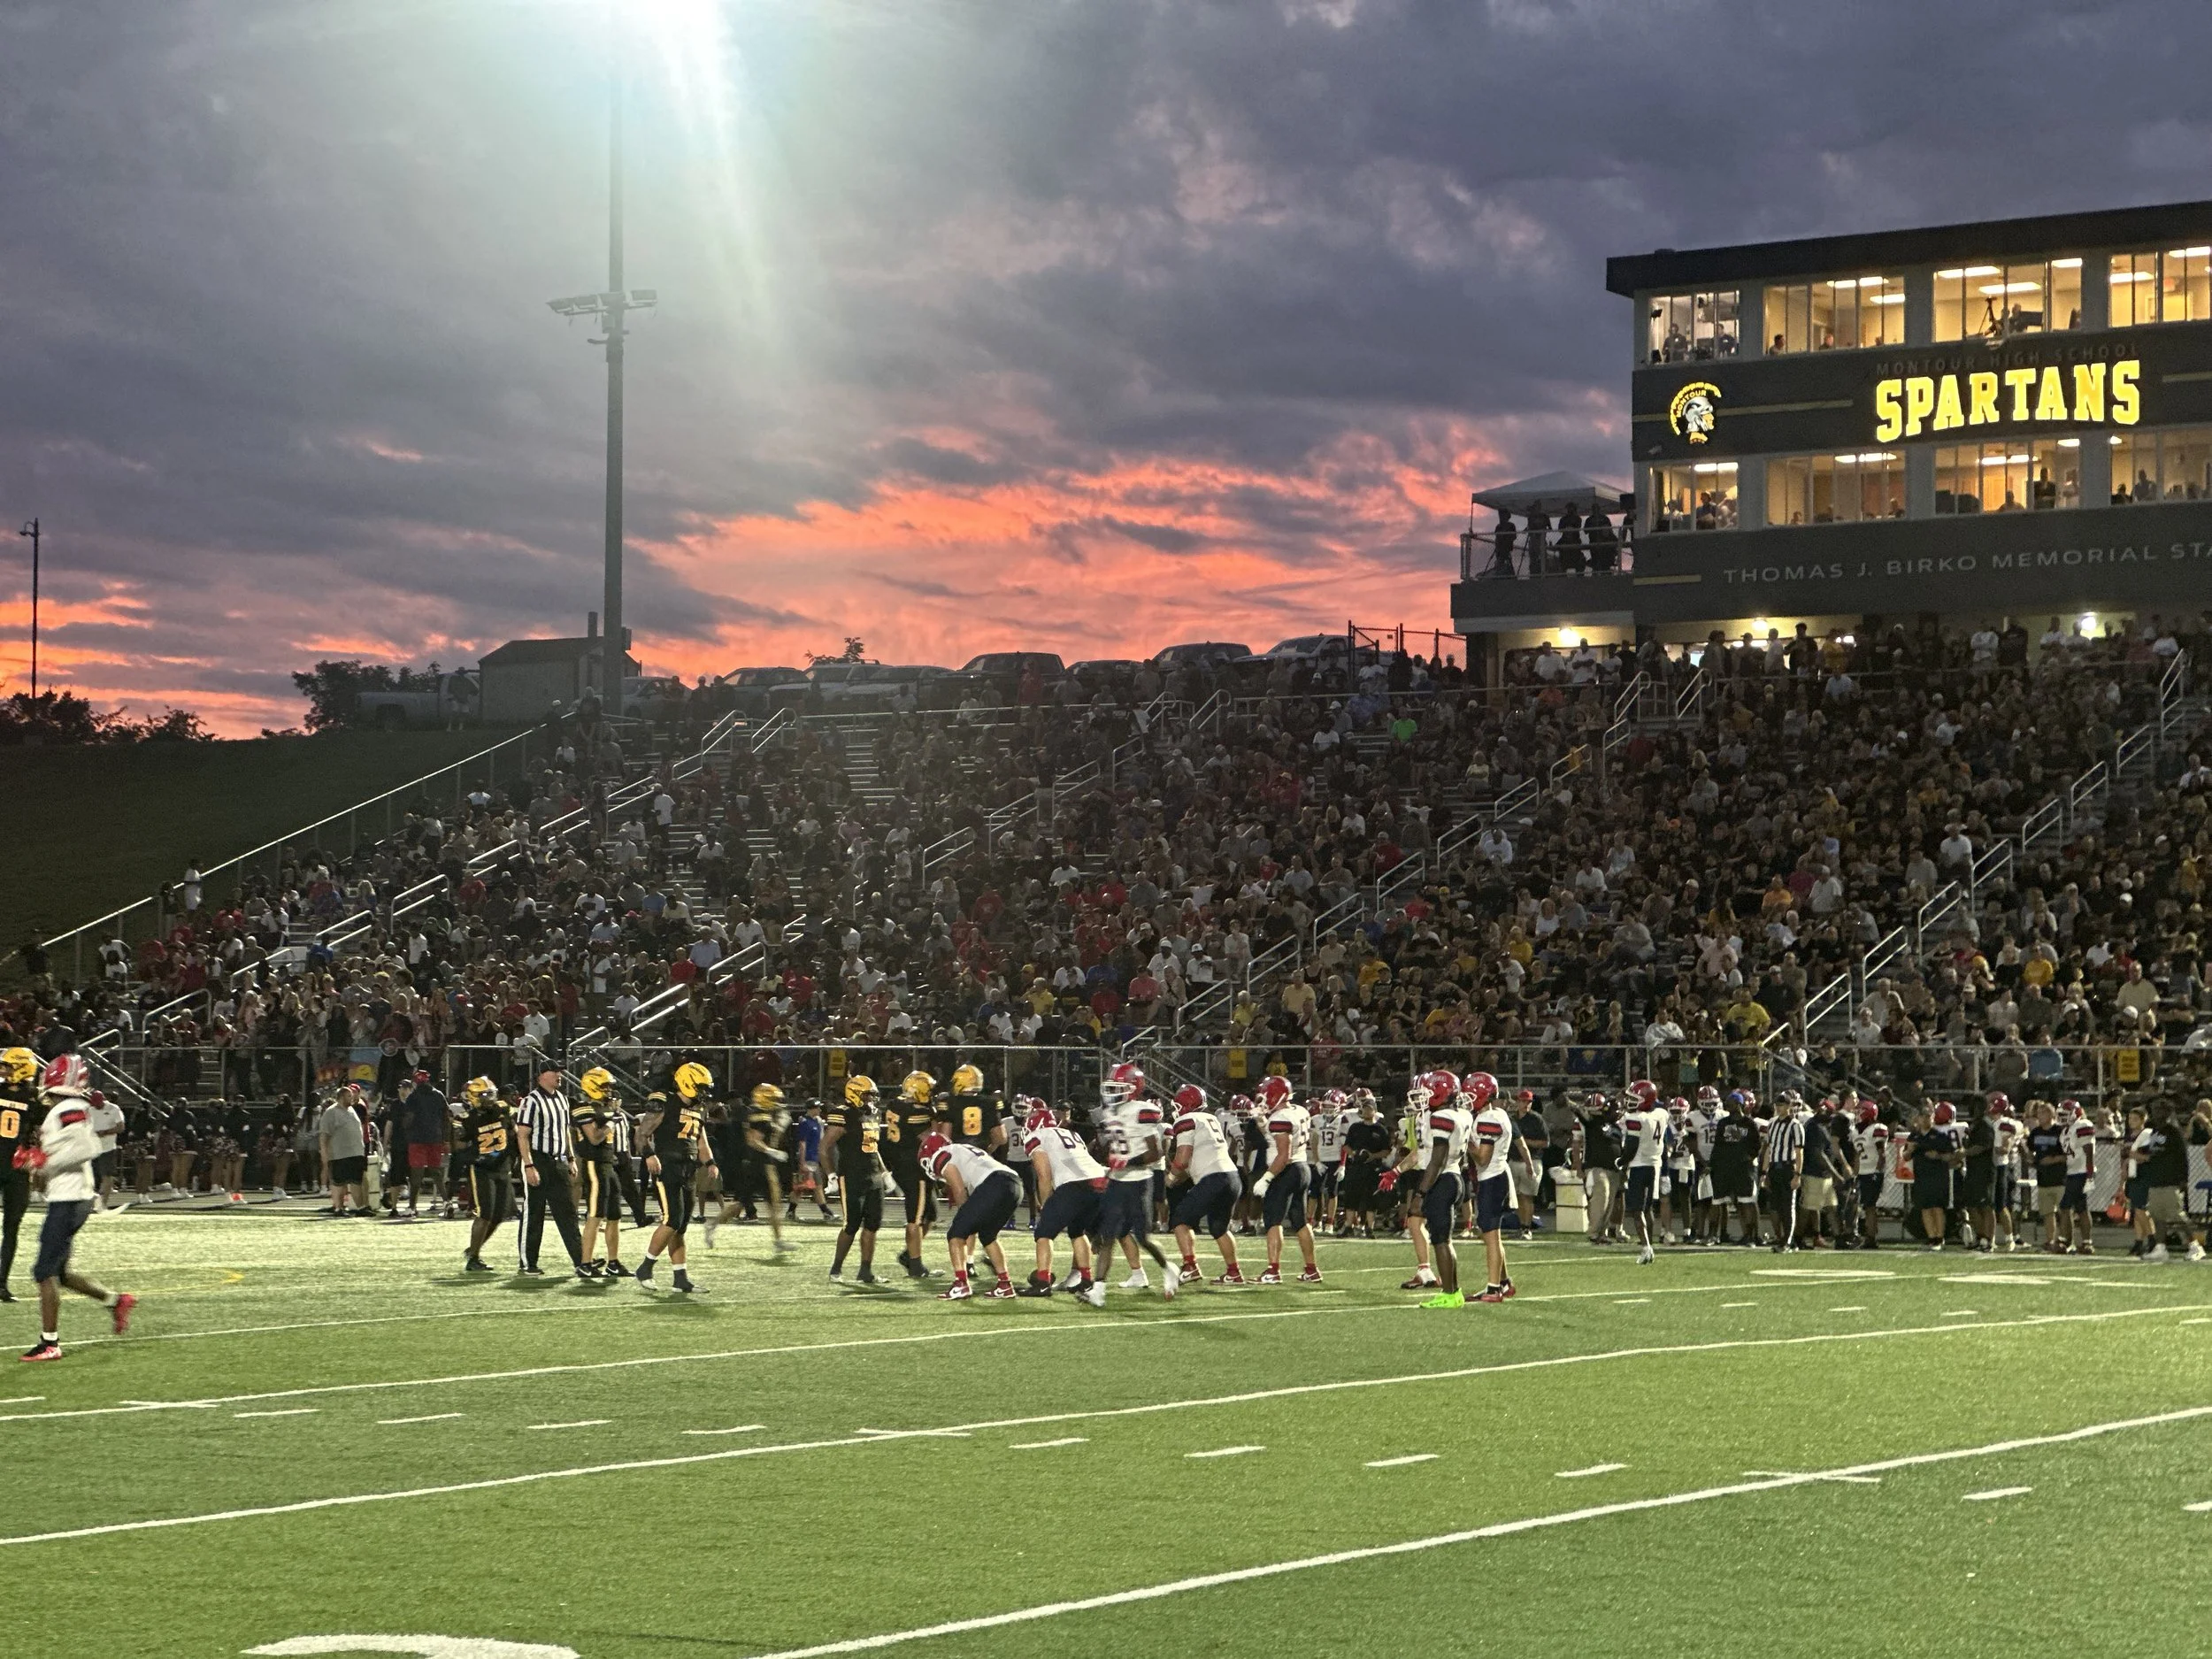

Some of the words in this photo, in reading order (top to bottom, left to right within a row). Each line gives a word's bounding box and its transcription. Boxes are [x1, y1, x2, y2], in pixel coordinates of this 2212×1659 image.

[1876, 356, 1976, 376] MONTOUR
[1990, 349, 2039, 368] HIGH
[2055, 342, 2139, 363] SCHOOL
[1676, 389, 1708, 419] MONTOUR
[1876, 359, 2140, 443] SPARTANS
[1724, 563, 1844, 584] THOMAS
[1857, 562, 1873, 577] J.
[1886, 555, 1978, 576] BIRKO
[1992, 546, 2158, 569] MEMORIAL
[963, 1106, 983, 1136] 8
[1652, 1120, 1662, 1146] 4
[478, 1128, 507, 1155] 23
[1322, 1131, 1334, 1147] 13
